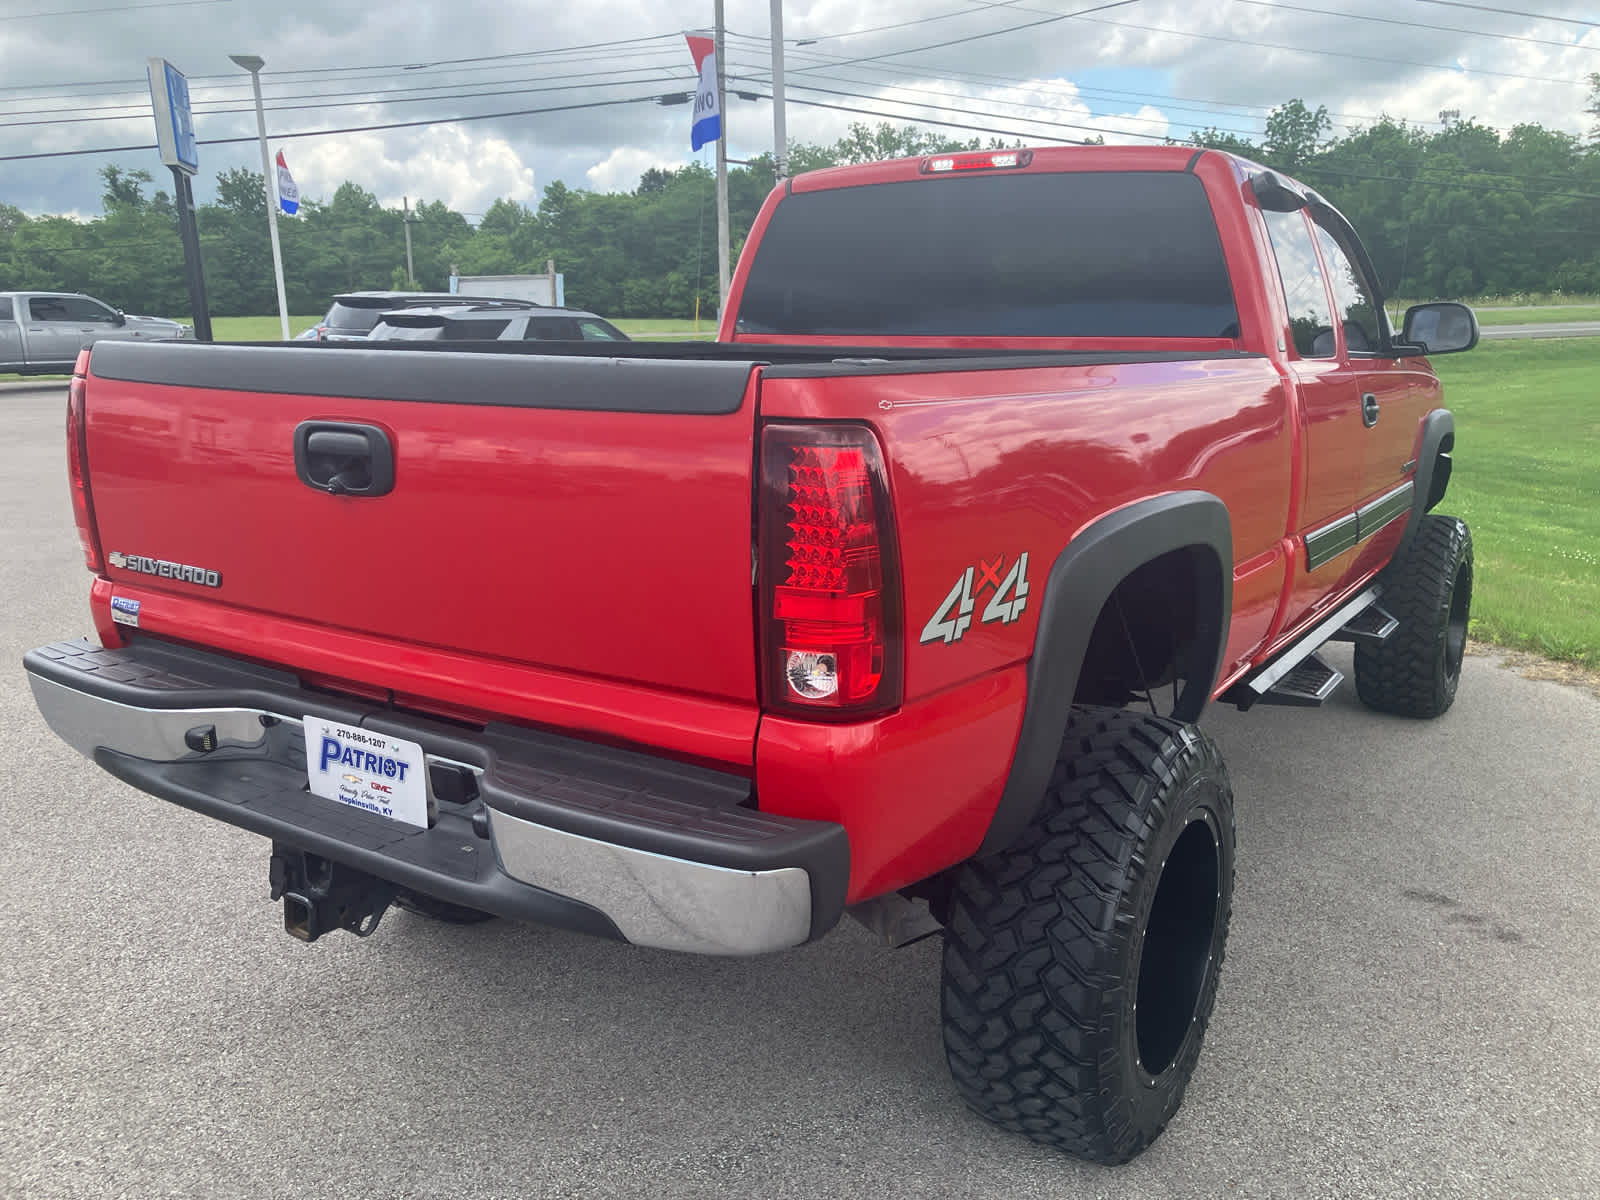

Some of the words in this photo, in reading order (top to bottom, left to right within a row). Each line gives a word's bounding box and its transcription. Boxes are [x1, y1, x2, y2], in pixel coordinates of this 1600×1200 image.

[126, 555, 220, 587] SILVERADO
[336, 728, 387, 750] 270-886-1207
[319, 735, 410, 782] PATRIOT
[370, 782, 393, 795] GMC
[338, 793, 381, 815] Hopkinsville,
[383, 807, 393, 817] KY
